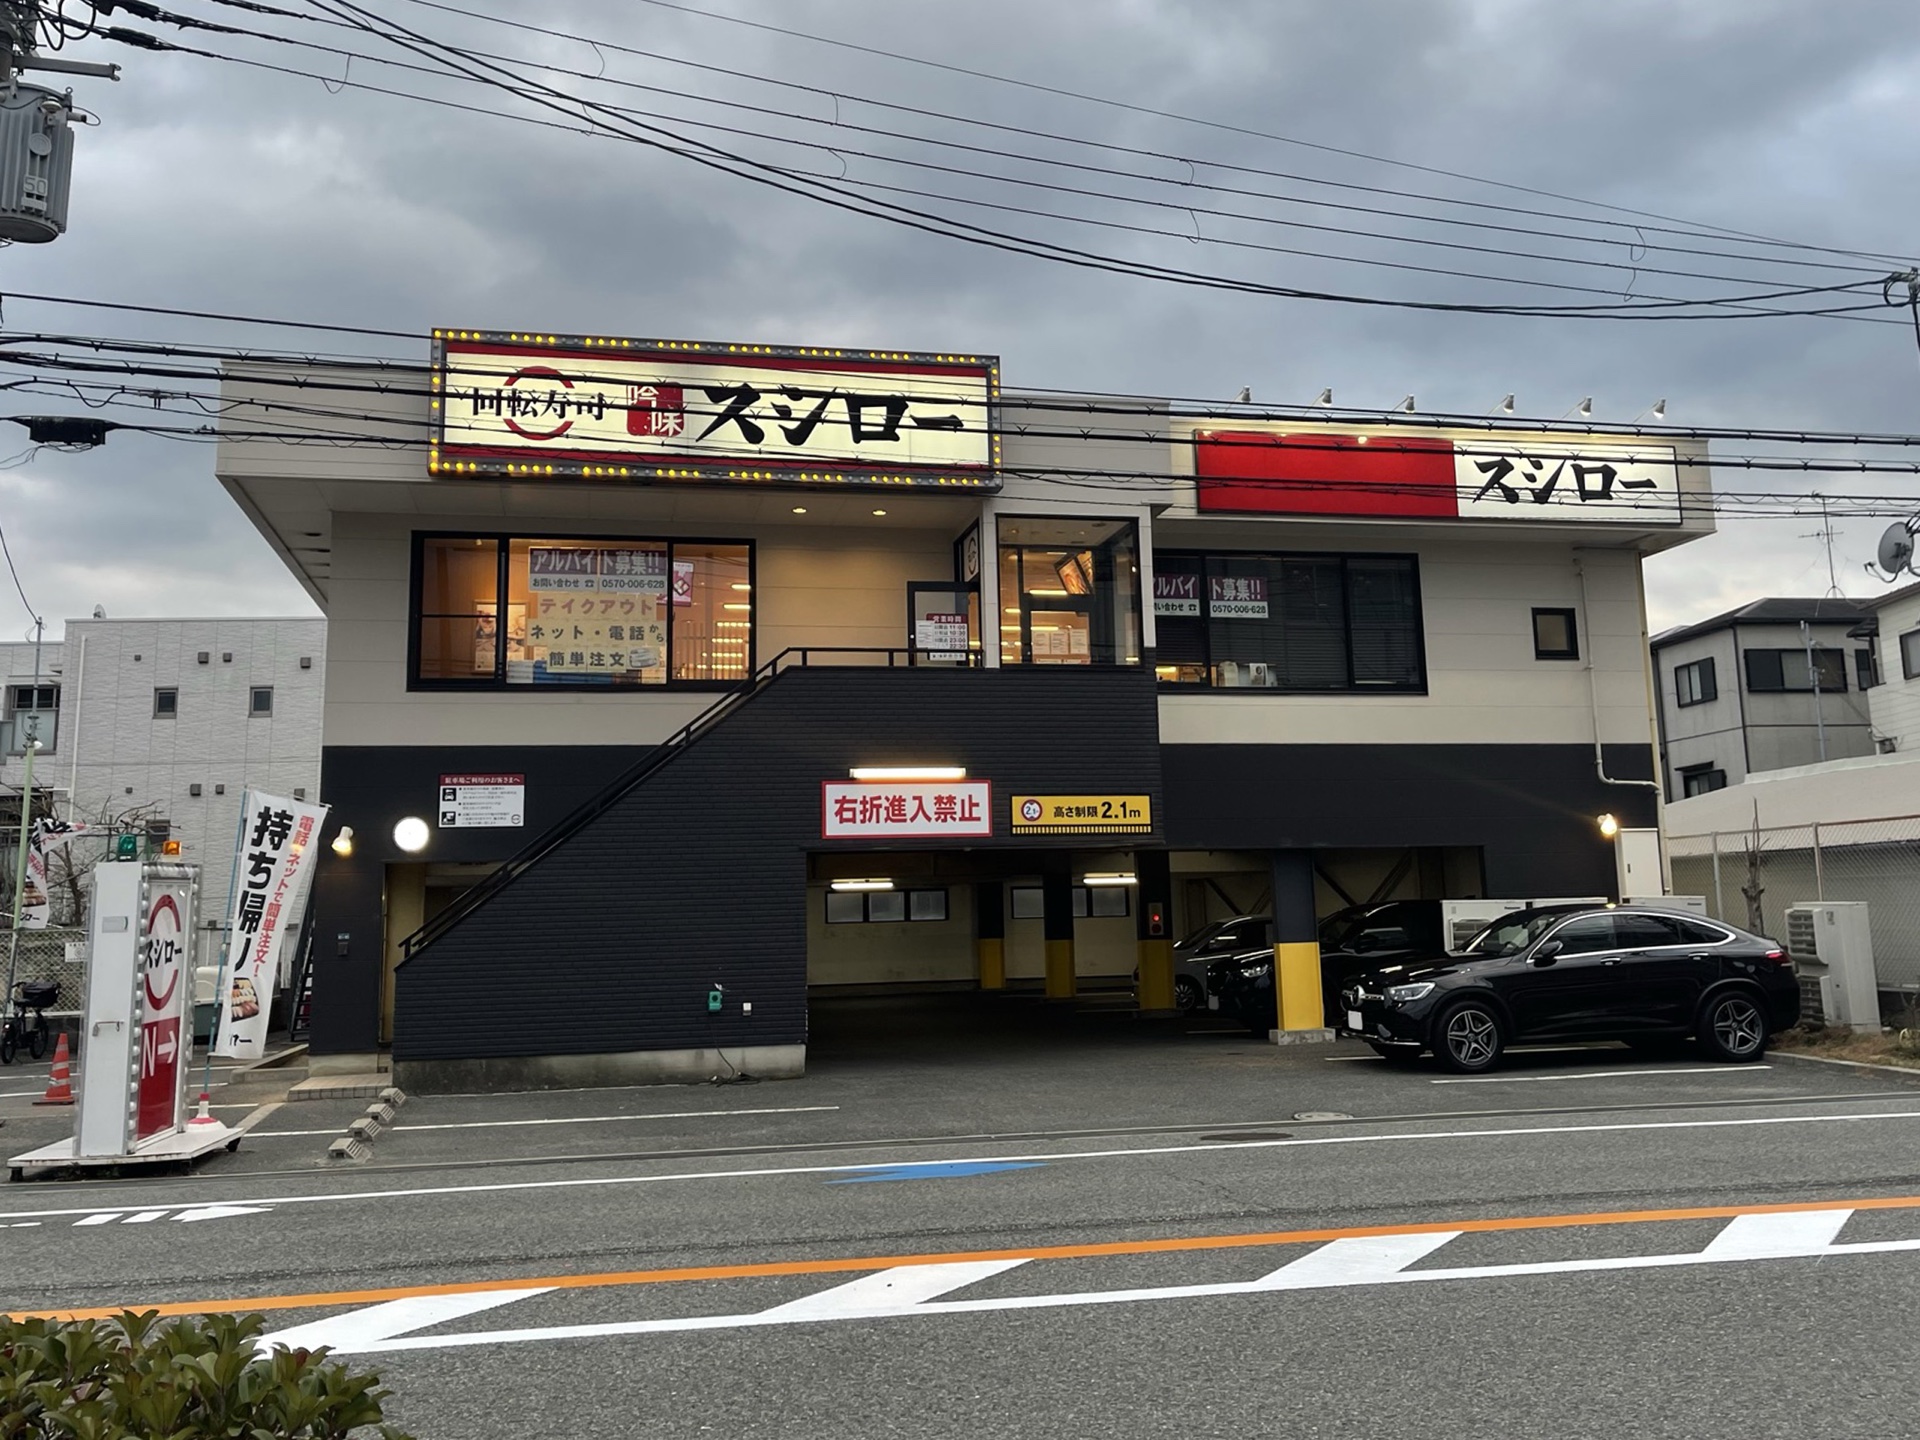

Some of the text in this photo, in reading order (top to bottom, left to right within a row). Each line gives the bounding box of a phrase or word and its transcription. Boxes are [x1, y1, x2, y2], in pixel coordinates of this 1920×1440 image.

[24, 176, 47, 195] 50
[627, 385, 683, 436] 吟味
[695, 382, 965, 446] スシロー
[1472, 457, 1658, 504] スシロー
[602, 580, 665, 589] 0570-006-628
[540, 599, 652, 615] テイクアウト
[1212, 604, 1267, 614] 0570-006-628
[549, 651, 626, 668] 簡単注文
[834, 794, 982, 824] 右折進入禁止
